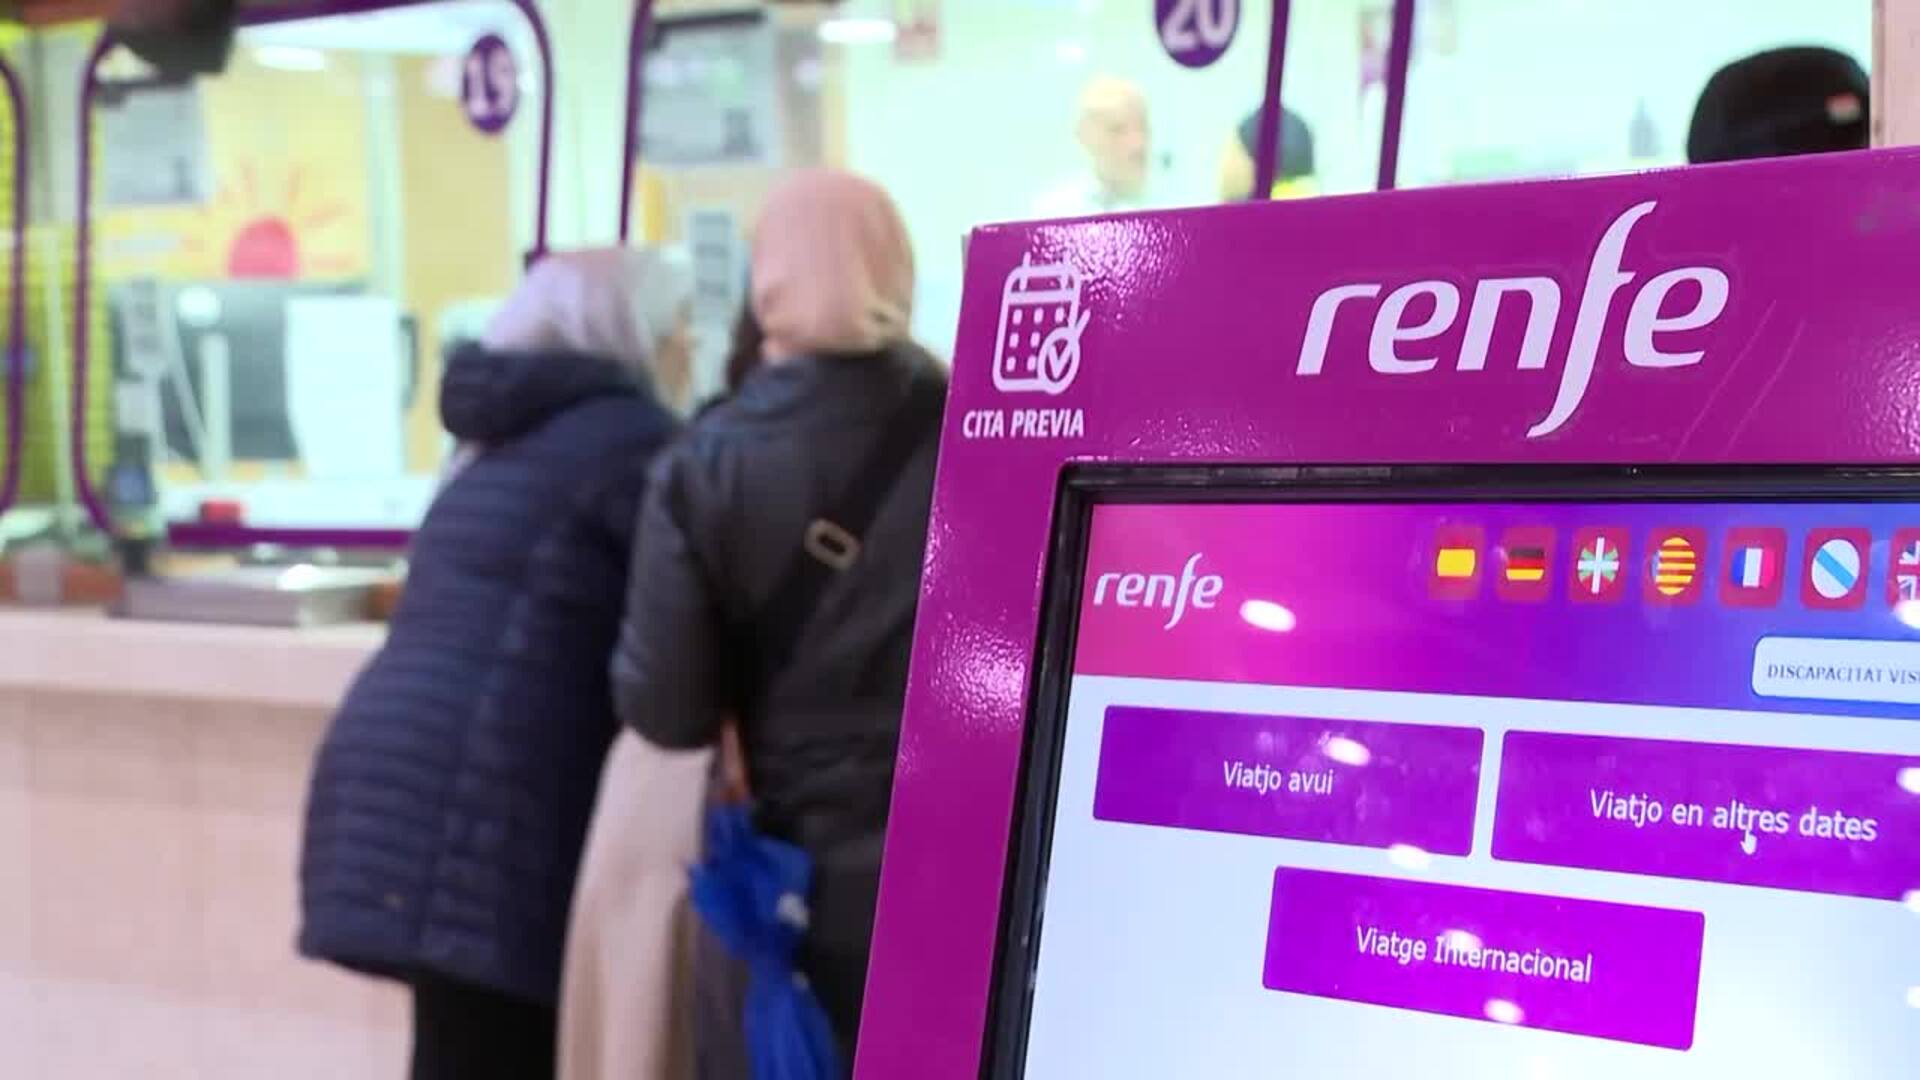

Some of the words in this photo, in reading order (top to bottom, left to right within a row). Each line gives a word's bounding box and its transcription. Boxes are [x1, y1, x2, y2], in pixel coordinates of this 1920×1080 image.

[1162, 0, 1236, 48] 20
[1296, 200, 1730, 438] renfe
[962, 410, 1004, 438] CITA
[1010, 409, 1085, 437] PREVIA
[1093, 552, 1224, 630] renfe
[1767, 664, 1882, 683] DISCAPACITAT
[1889, 669, 1920, 685] VIS
[1223, 760, 1283, 796] Viatjo
[1288, 769, 1334, 795] avui
[1590, 789, 1664, 828] Viatjo
[1672, 803, 1703, 827] en
[1712, 799, 1790, 834] altres
[1799, 807, 1878, 842] dates
[1355, 924, 1428, 965] Viatge
[1433, 935, 1593, 983] Internacional
